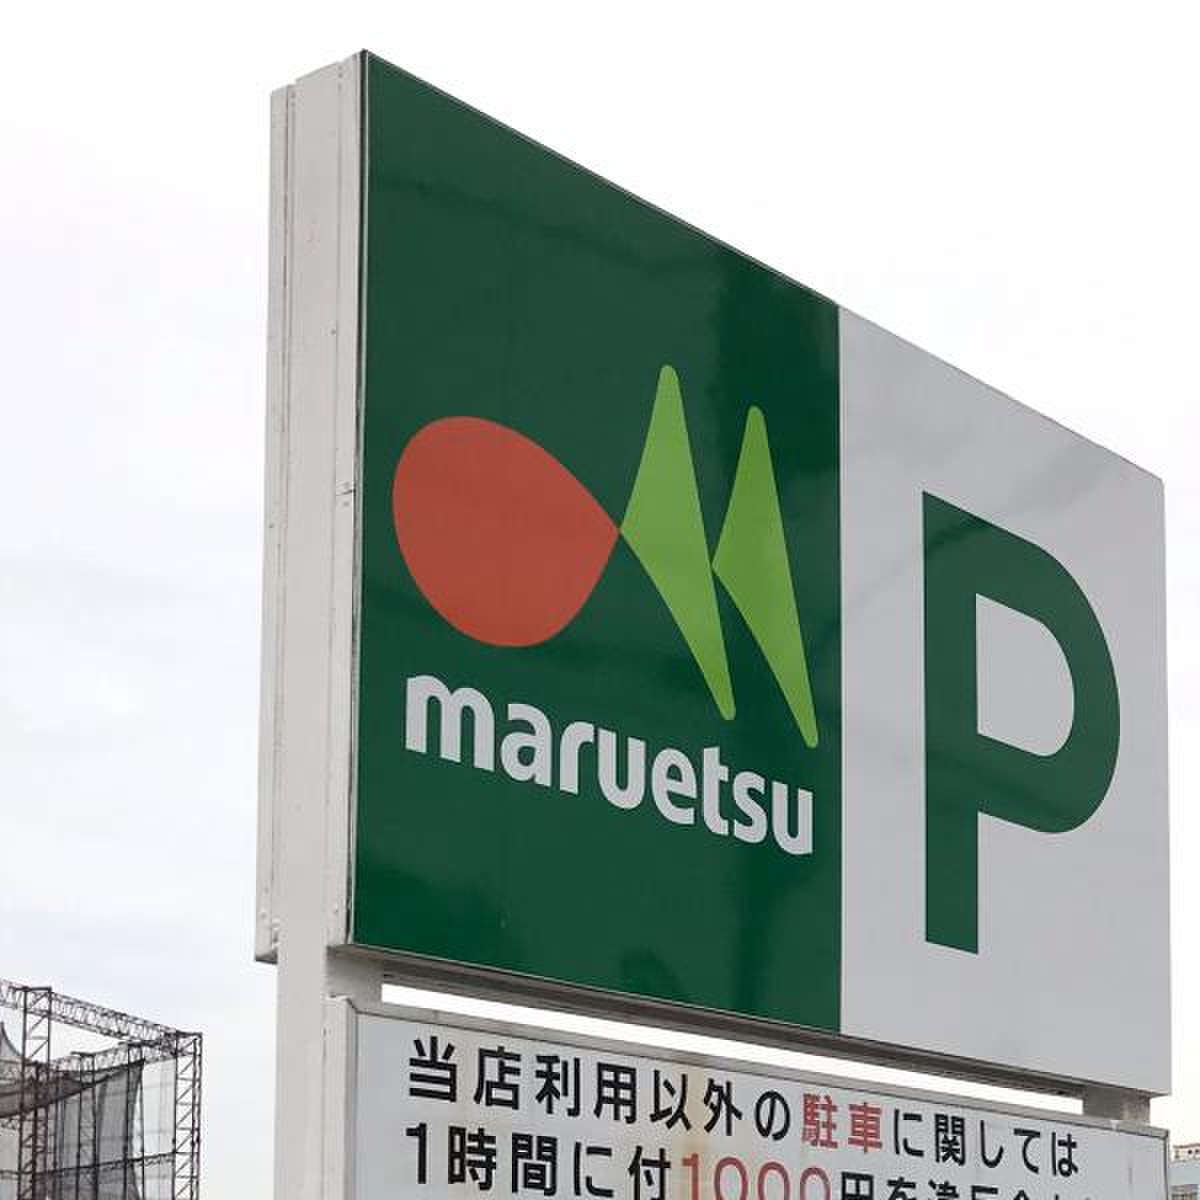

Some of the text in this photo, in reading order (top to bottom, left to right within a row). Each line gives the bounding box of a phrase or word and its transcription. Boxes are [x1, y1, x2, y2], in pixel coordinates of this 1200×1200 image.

[404, 673, 815, 857] maruetsu
[922, 490, 1122, 956] P
[406, 1035, 1079, 1177] 当店利用以外の駐車に関しては
